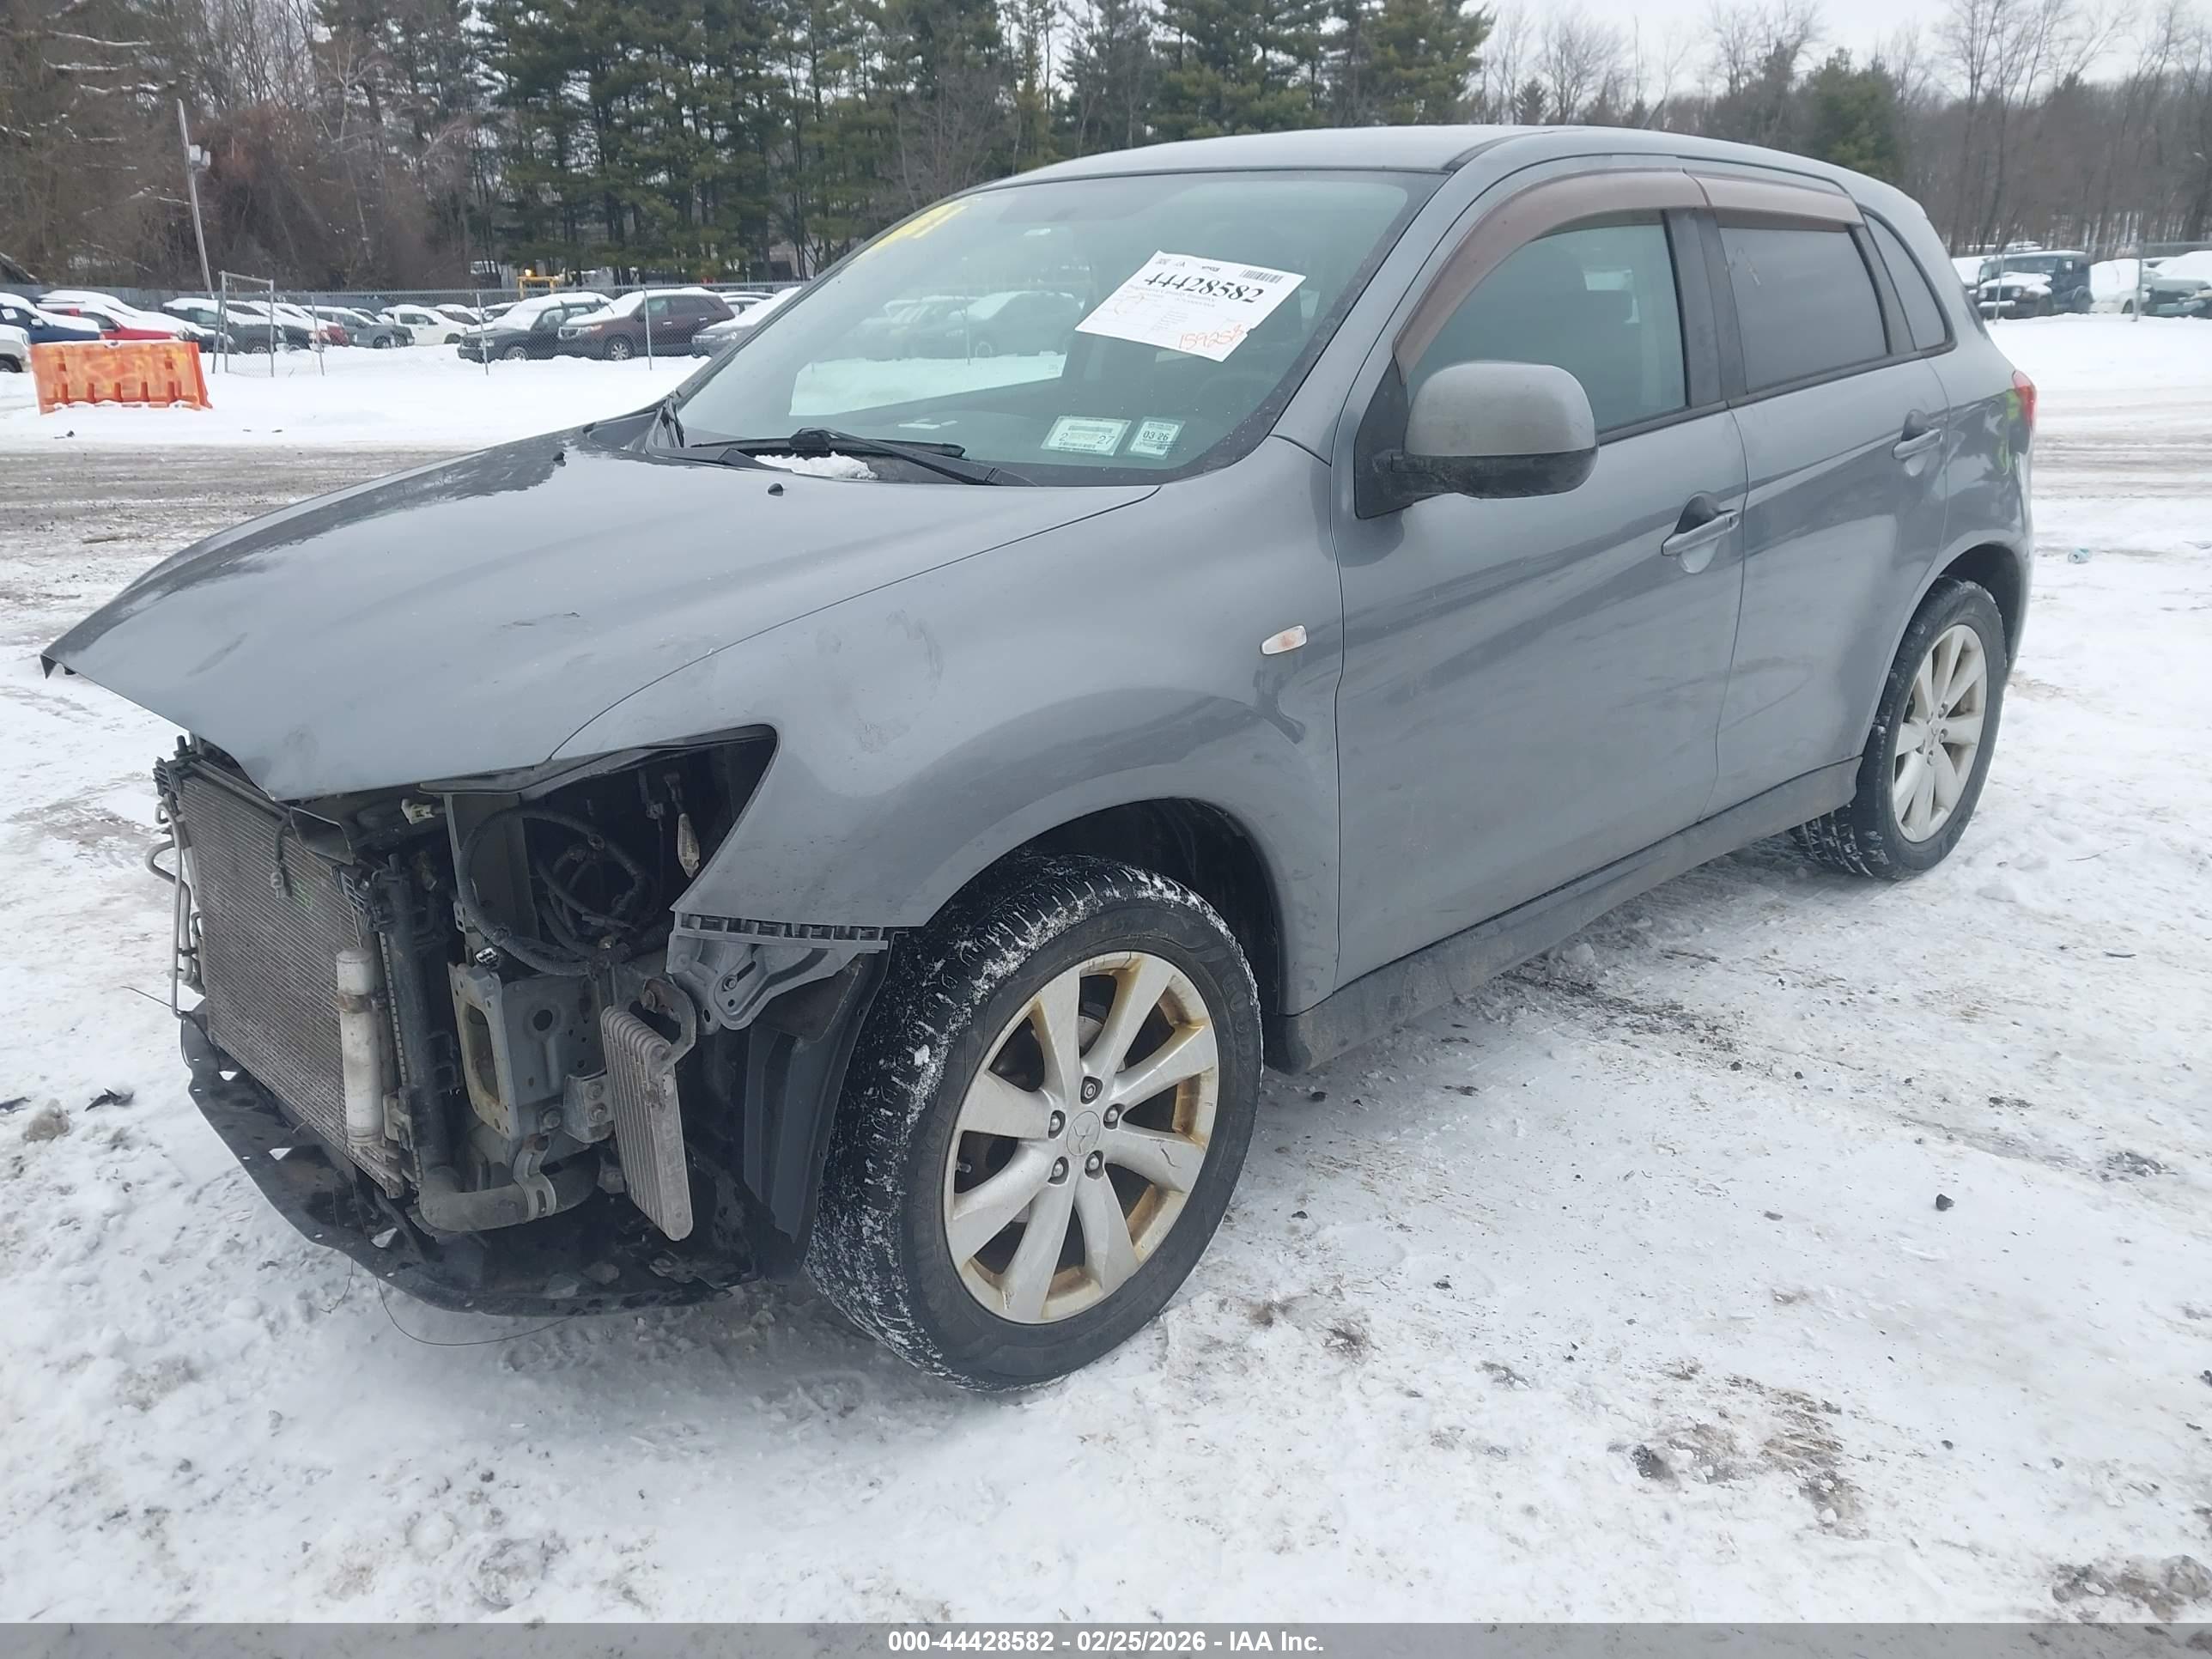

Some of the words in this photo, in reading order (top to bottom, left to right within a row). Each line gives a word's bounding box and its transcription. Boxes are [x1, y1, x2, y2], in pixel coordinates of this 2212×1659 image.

[1144, 271, 1265, 303] 44428582
[1059, 432, 1069, 442] 2
[1097, 434, 1115, 446] 27
[1142, 430, 1156, 440] 03
[1157, 432, 1170, 441] 26
